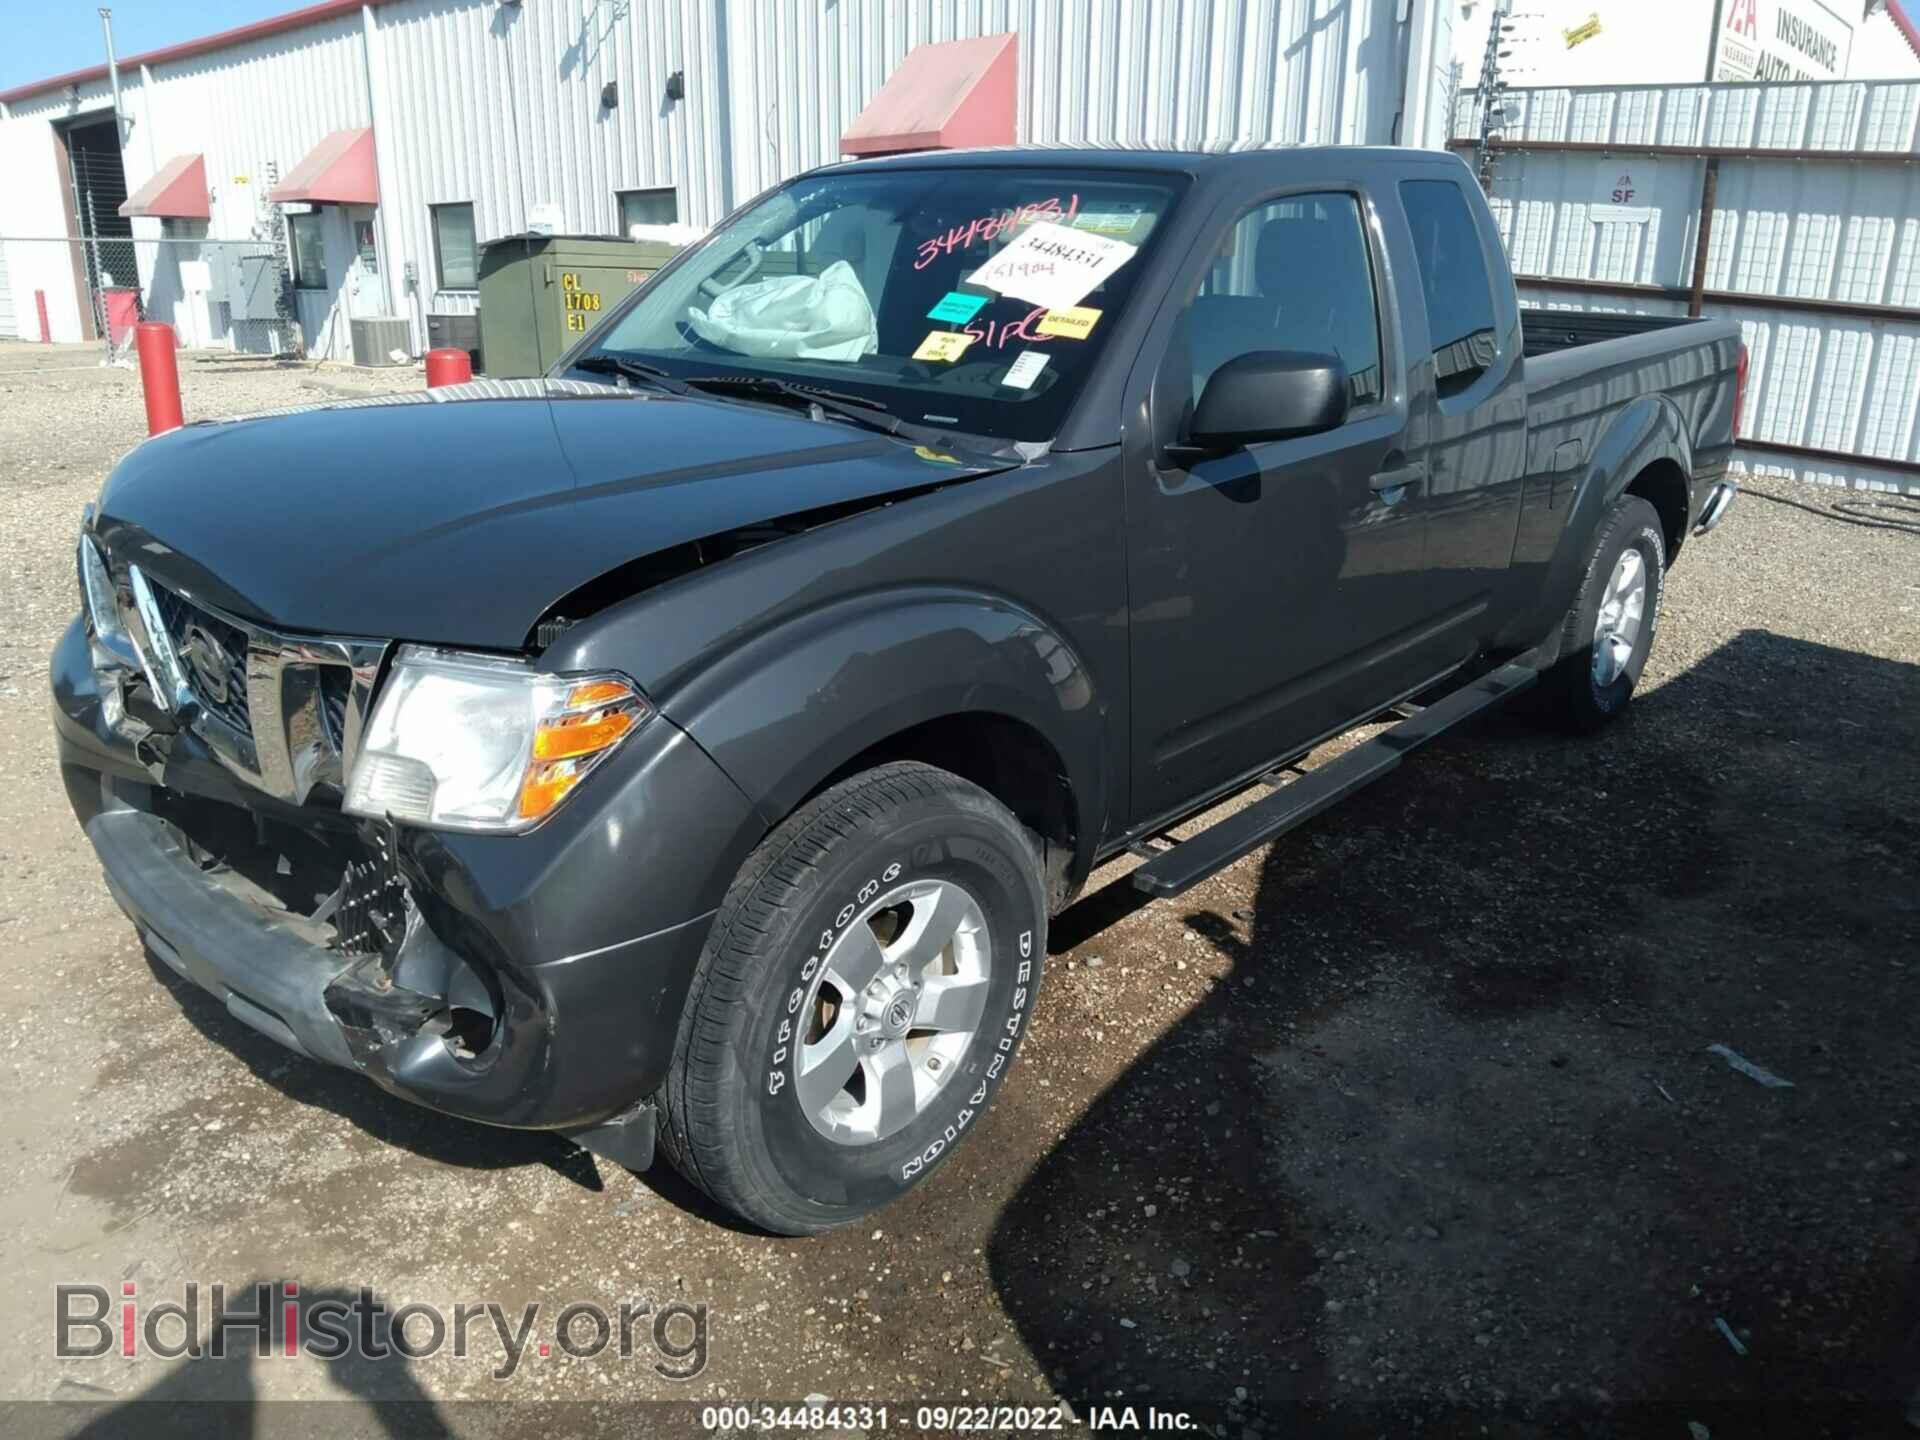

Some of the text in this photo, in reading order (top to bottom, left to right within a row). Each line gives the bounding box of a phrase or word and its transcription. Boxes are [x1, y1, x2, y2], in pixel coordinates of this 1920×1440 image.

[1776, 7, 1837, 73] INSURANCE
[1753, 49, 1791, 81] AUTO
[1611, 190, 1635, 202] SF
[563, 273, 581, 290] CL
[565, 293, 600, 311] 1708
[567, 313, 584, 331] E1
[1047, 315, 1090, 327] DETAILED
[902, 930, 1032, 1180] DESTINATION
